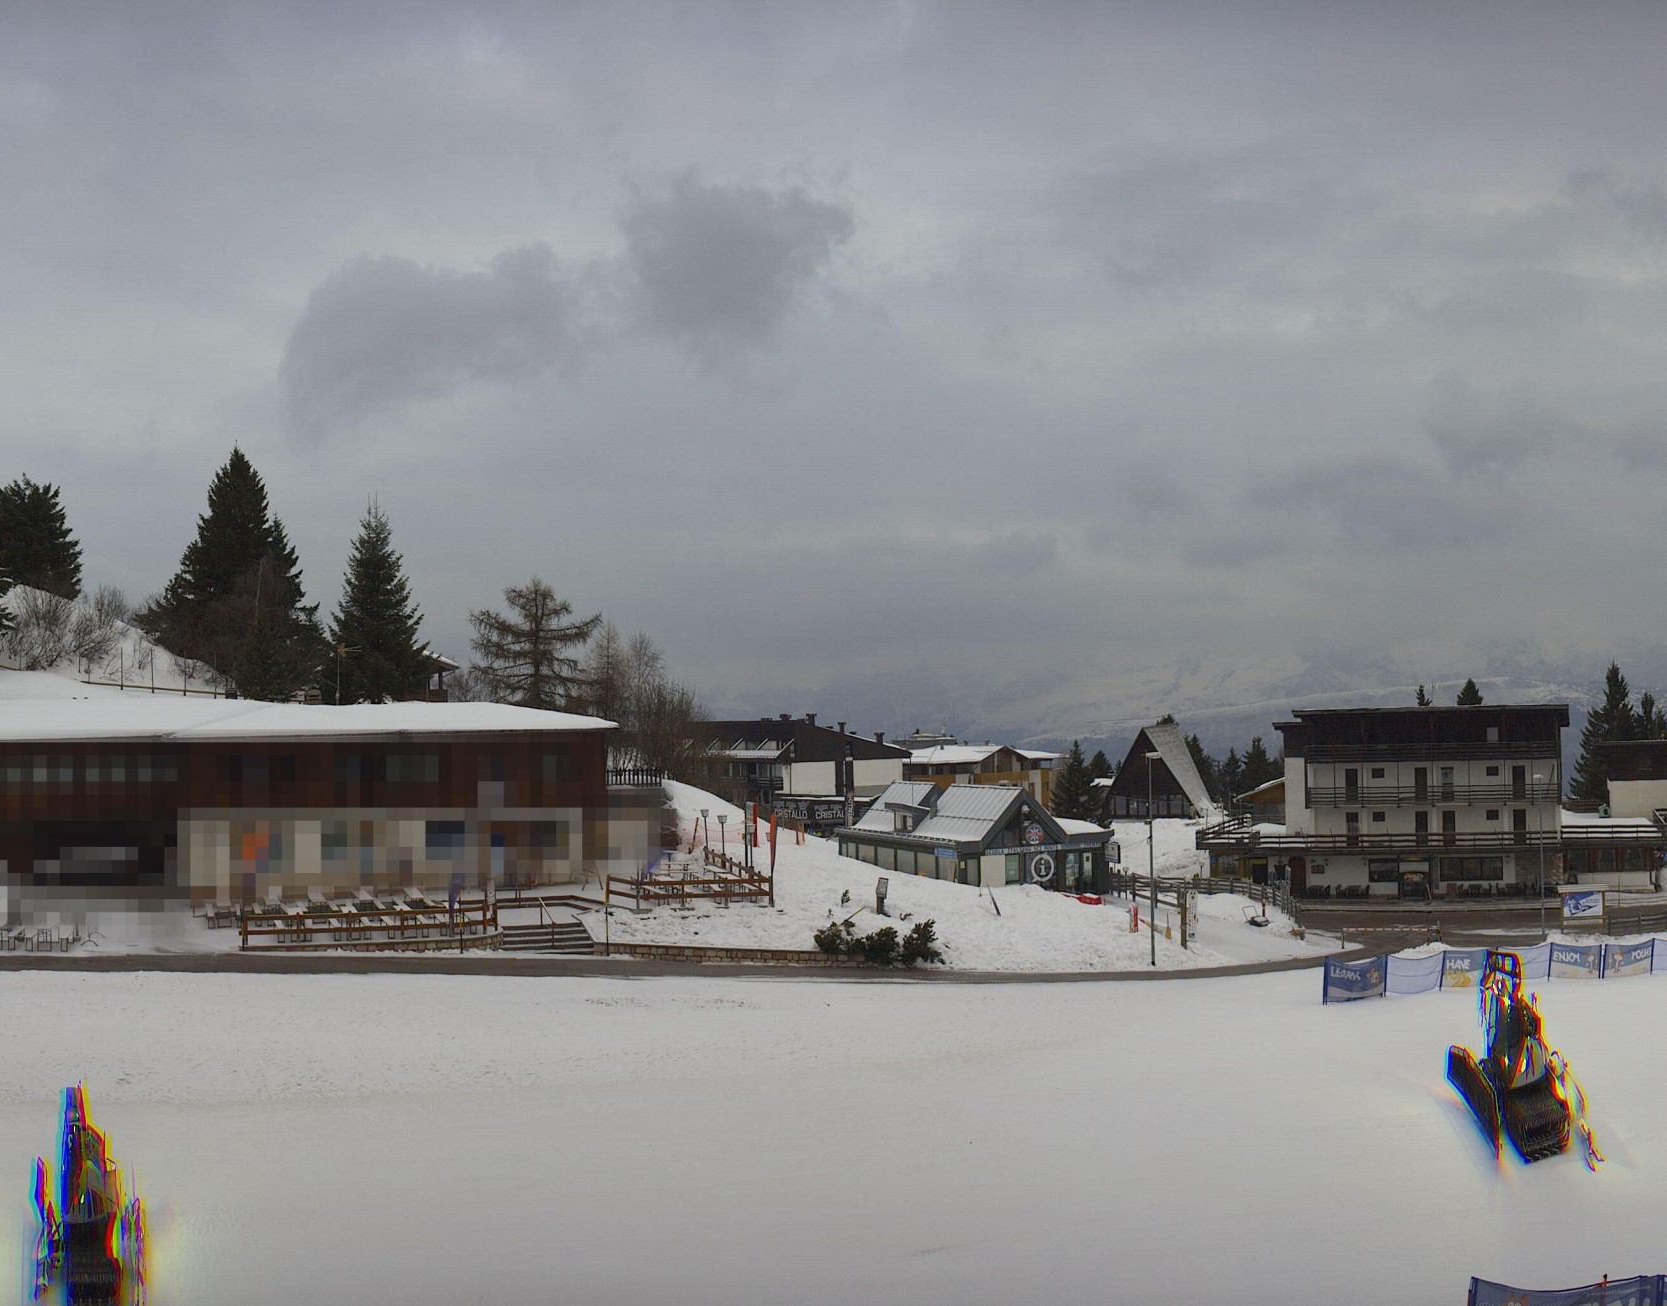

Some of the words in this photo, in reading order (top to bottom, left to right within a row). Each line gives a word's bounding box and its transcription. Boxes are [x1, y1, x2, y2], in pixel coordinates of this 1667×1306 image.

[815, 810, 845, 820] CRISTAL
[1553, 950, 1580, 962] ENJOY
[1446, 959, 1471, 970] HAVE
